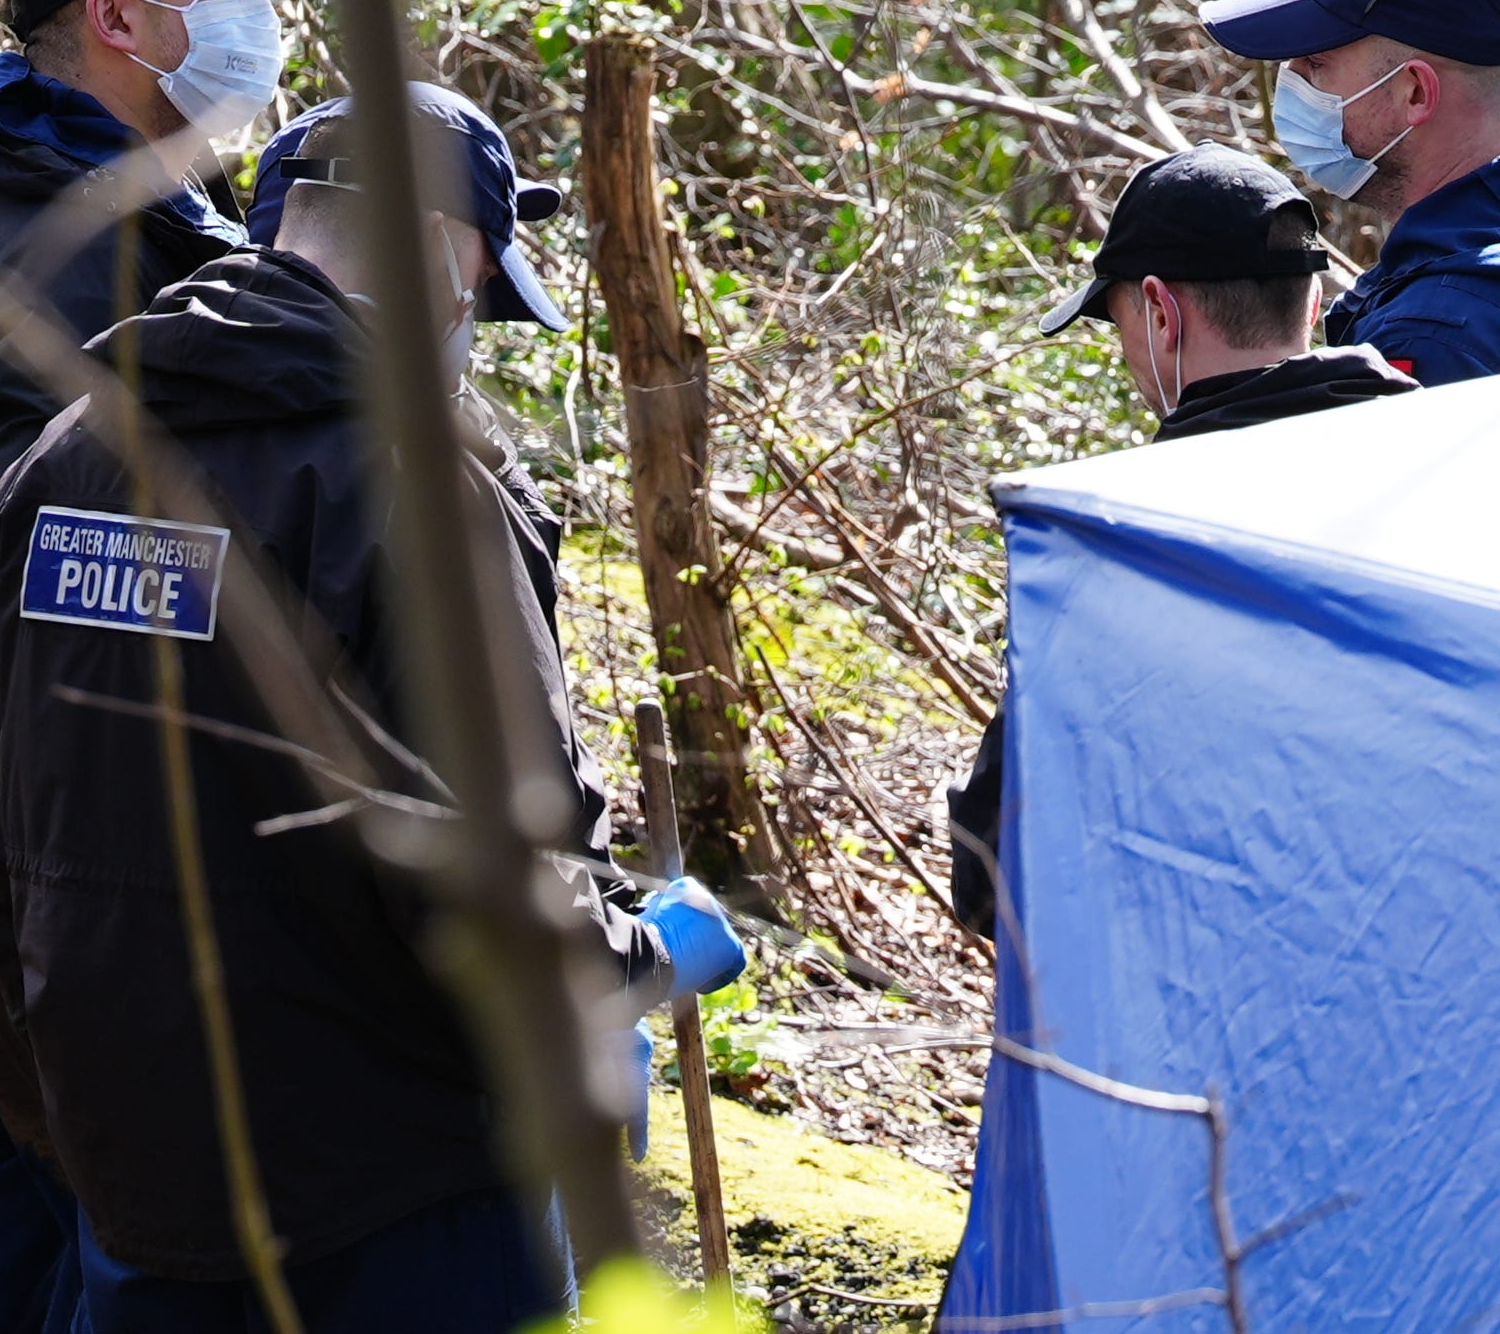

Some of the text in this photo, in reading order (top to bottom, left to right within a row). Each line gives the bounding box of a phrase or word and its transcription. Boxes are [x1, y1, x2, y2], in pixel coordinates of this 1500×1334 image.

[40, 523, 212, 570] GREATER MANCHESTER
[55, 559, 183, 619] POLICE
